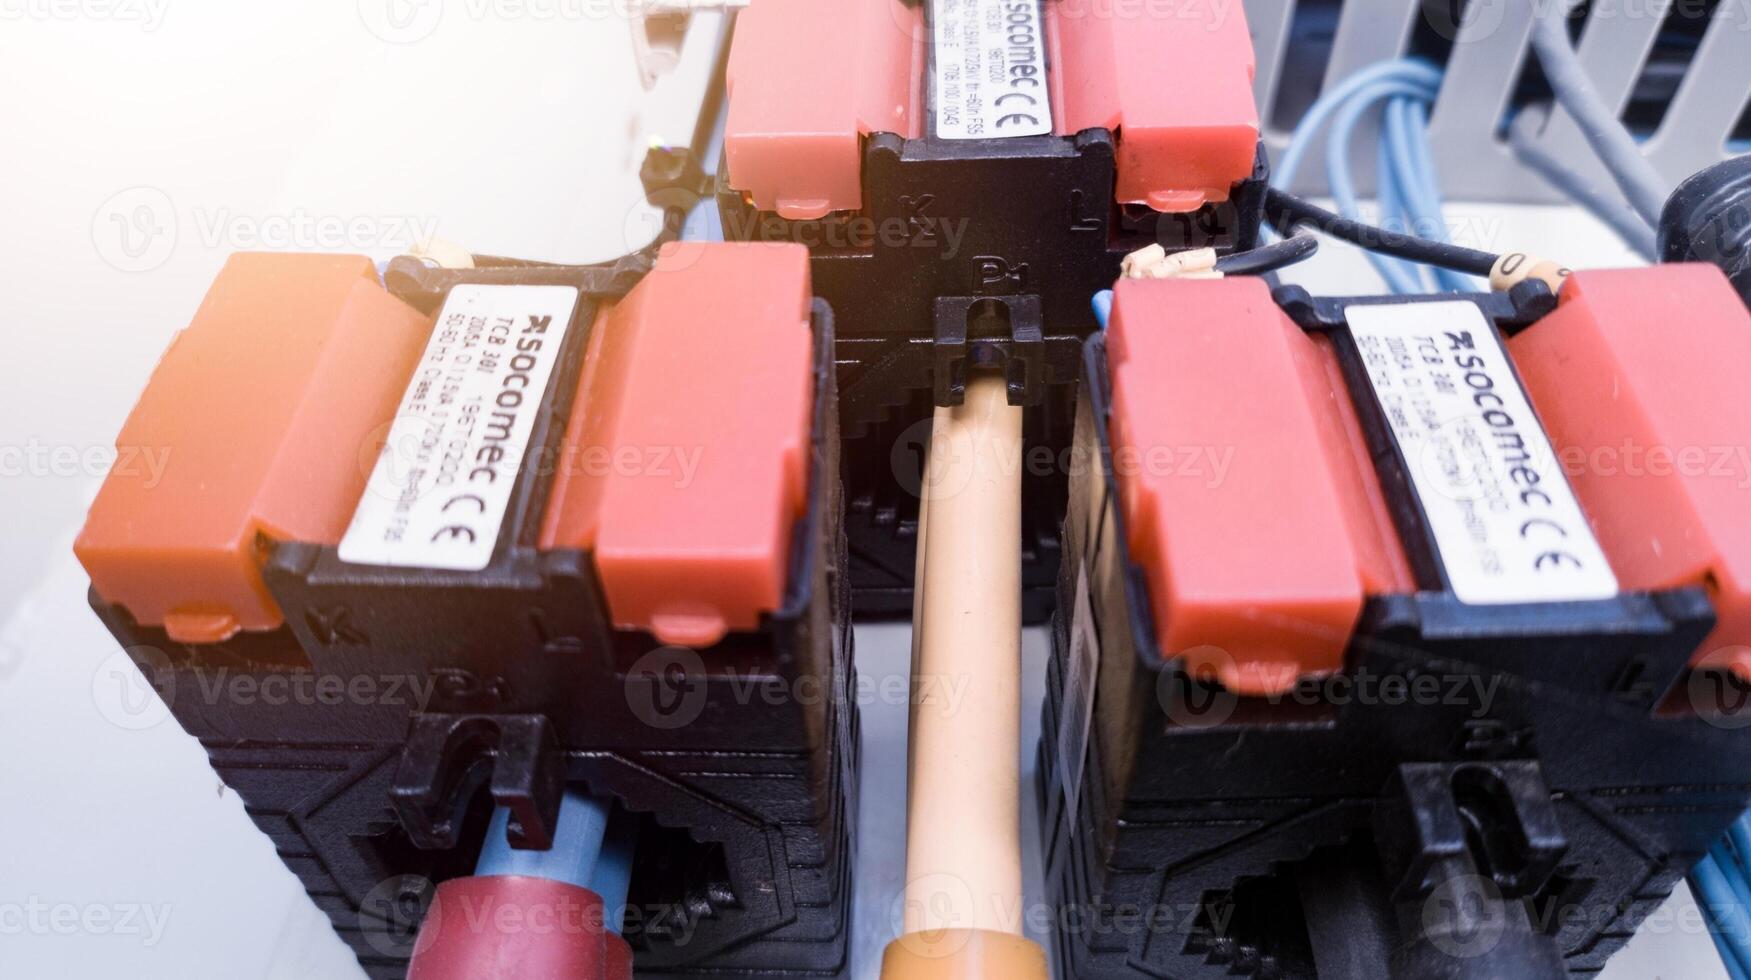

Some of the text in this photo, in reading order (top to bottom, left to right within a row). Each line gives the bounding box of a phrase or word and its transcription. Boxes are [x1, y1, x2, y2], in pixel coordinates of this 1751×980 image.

[1003, 3, 1039, 87] socomec
[487, 316, 513, 346] TCB
[466, 336, 544, 484] socomec
[1452, 353, 1553, 507] socomec
